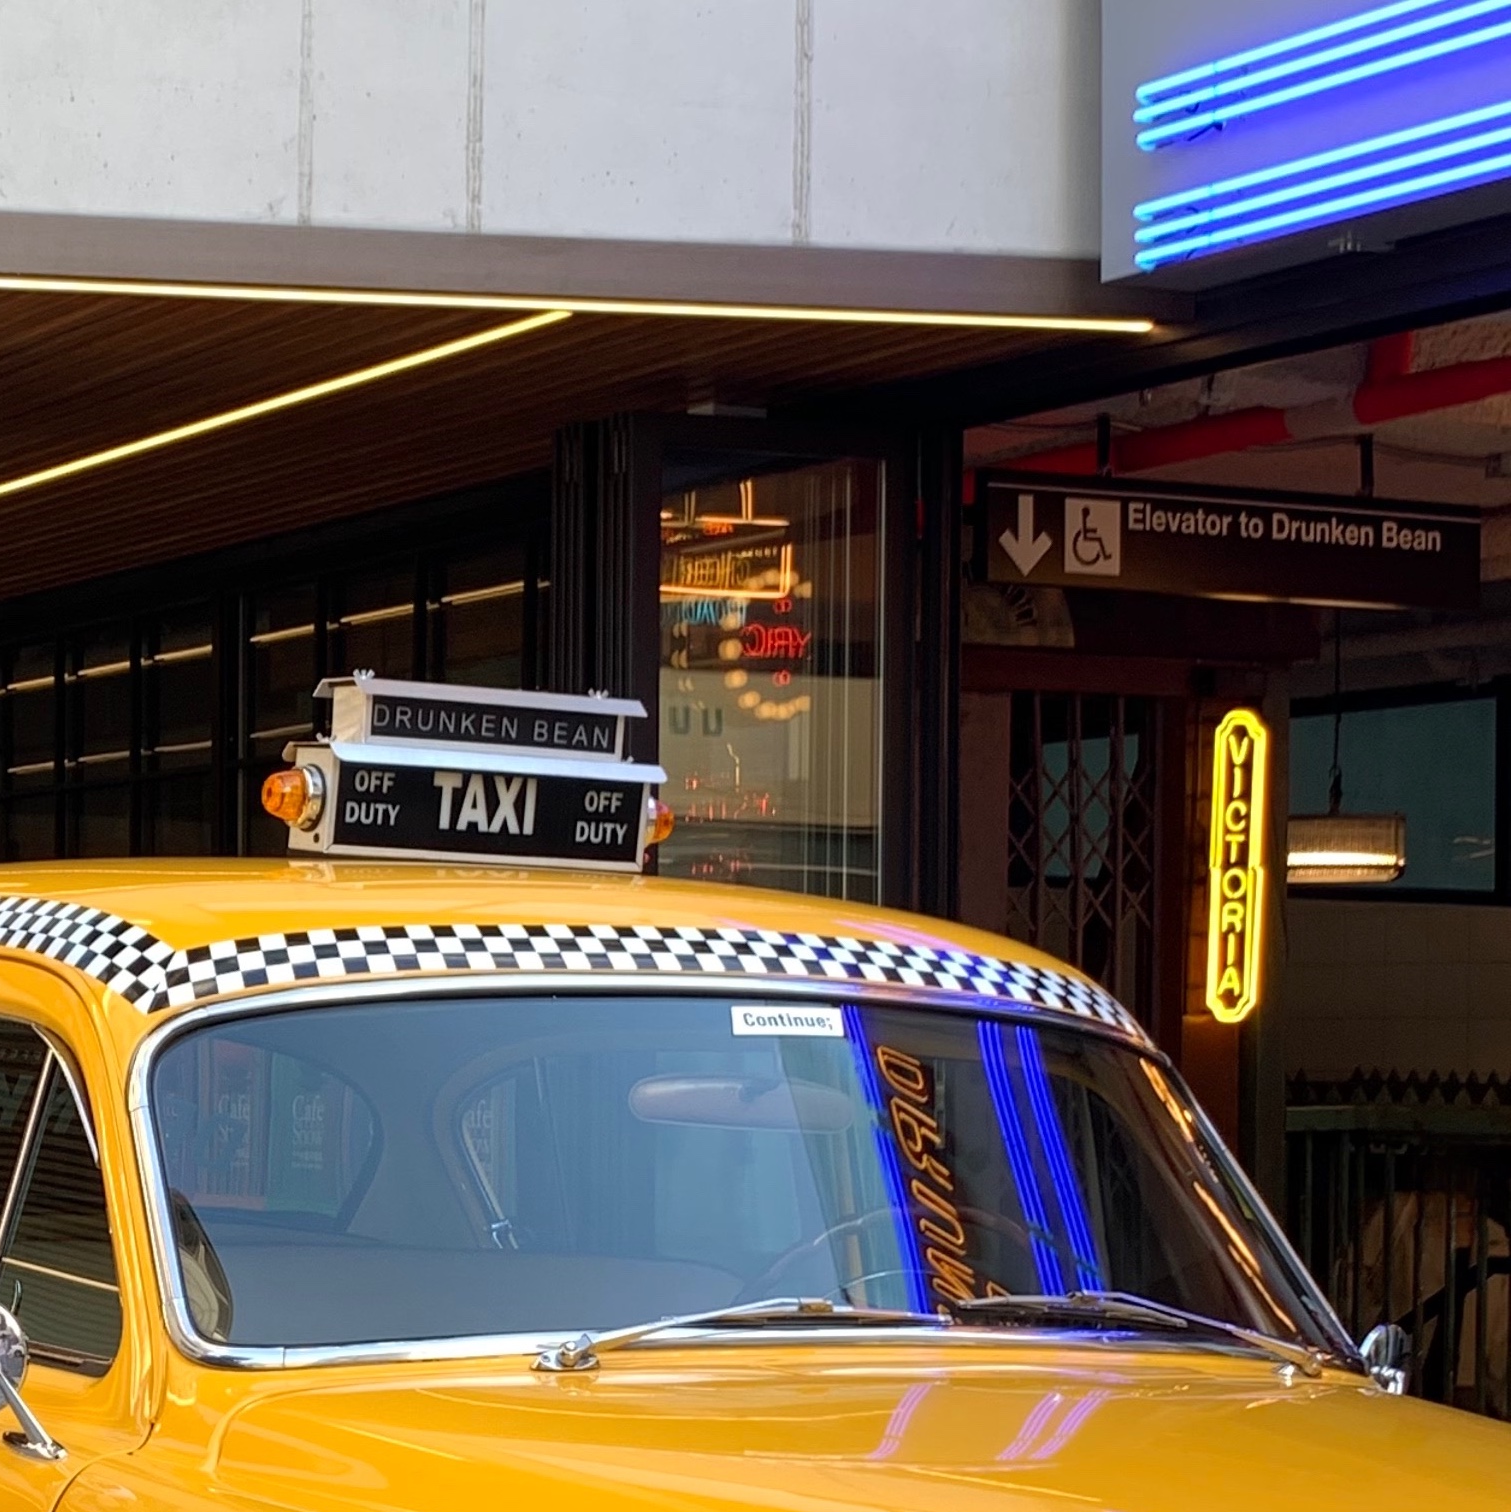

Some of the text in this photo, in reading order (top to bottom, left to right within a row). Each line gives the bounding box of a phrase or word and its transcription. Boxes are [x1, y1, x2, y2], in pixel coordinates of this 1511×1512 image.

[1127, 501, 1442, 552] Elevator to Drunken Bean
[373, 703, 610, 749] DRUNKEN BEAN
[354, 769, 396, 795] OFF
[344, 801, 401, 827] DUTY
[433, 771, 538, 836] TAXI
[584, 790, 625, 815] OFF
[575, 821, 629, 846] DUTY
[1216, 733, 1249, 997] VICTORIA
